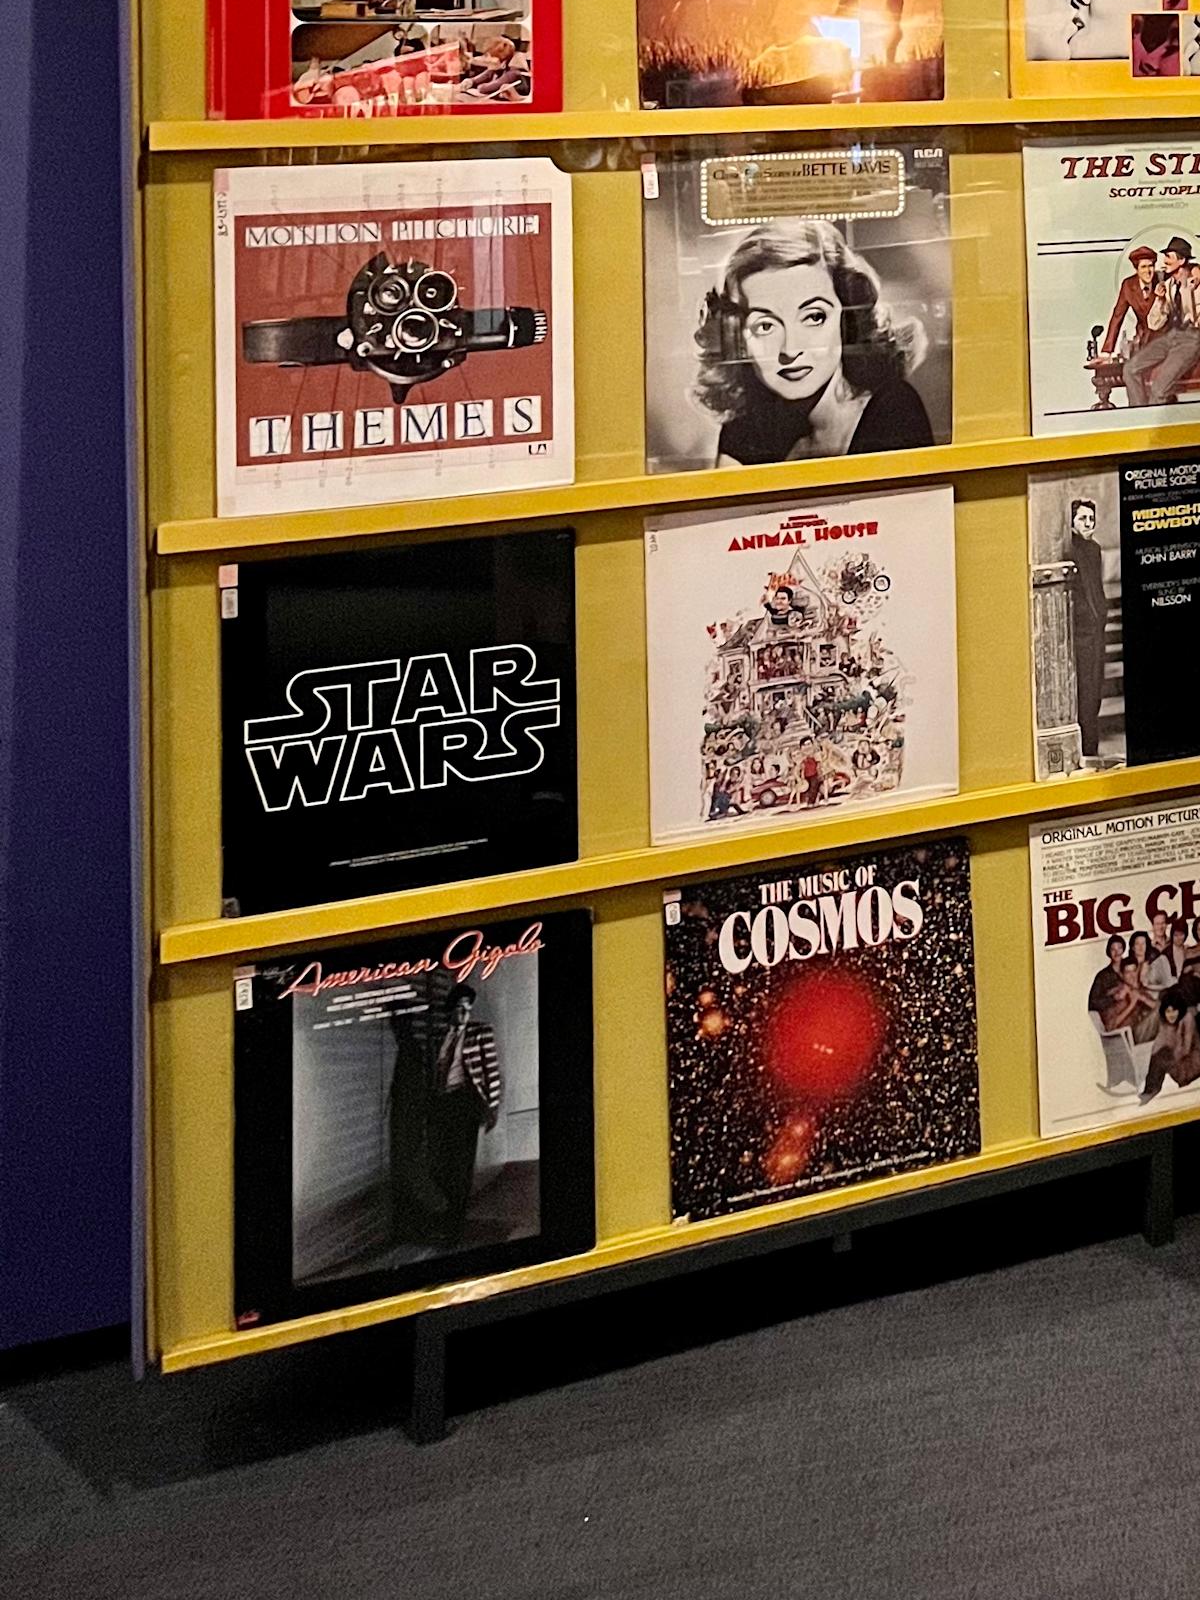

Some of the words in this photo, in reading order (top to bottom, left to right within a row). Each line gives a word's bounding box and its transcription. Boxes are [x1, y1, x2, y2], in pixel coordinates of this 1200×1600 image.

[802, 162, 847, 176] BETTE
[852, 160, 891, 175] DAVIS
[1061, 156, 1134, 179] THE
[1109, 186, 1154, 198] SCOTT
[247, 222, 380, 247] MOTION
[395, 216, 538, 240] PICTURE
[254, 397, 535, 454] THEMES
[1125, 468, 1167, 481] ORIGINAL
[1135, 476, 1168, 490] PICTURE
[1170, 474, 1197, 486] SCORE
[728, 530, 806, 552] ANIMAL
[816, 521, 879, 542] HOUSE
[1140, 552, 1166, 565] JOHN
[1169, 549, 1197, 561] BARRY
[1151, 594, 1192, 608] NILSSON
[244, 644, 560, 745] STAR
[245, 704, 560, 812] WARS
[1041, 822, 1102, 846] ORIGINAL
[1106, 815, 1154, 835] MOTION
[758, 880, 792, 905] THE
[798, 871, 850, 899] MUSIC
[854, 865, 877, 886] OF
[1043, 889, 1073, 904] THE
[718, 878, 925, 975] COSMOS
[1043, 892, 1134, 948] BIG
[278, 957, 439, 1000] American
[443, 921, 545, 983] Gigolo
